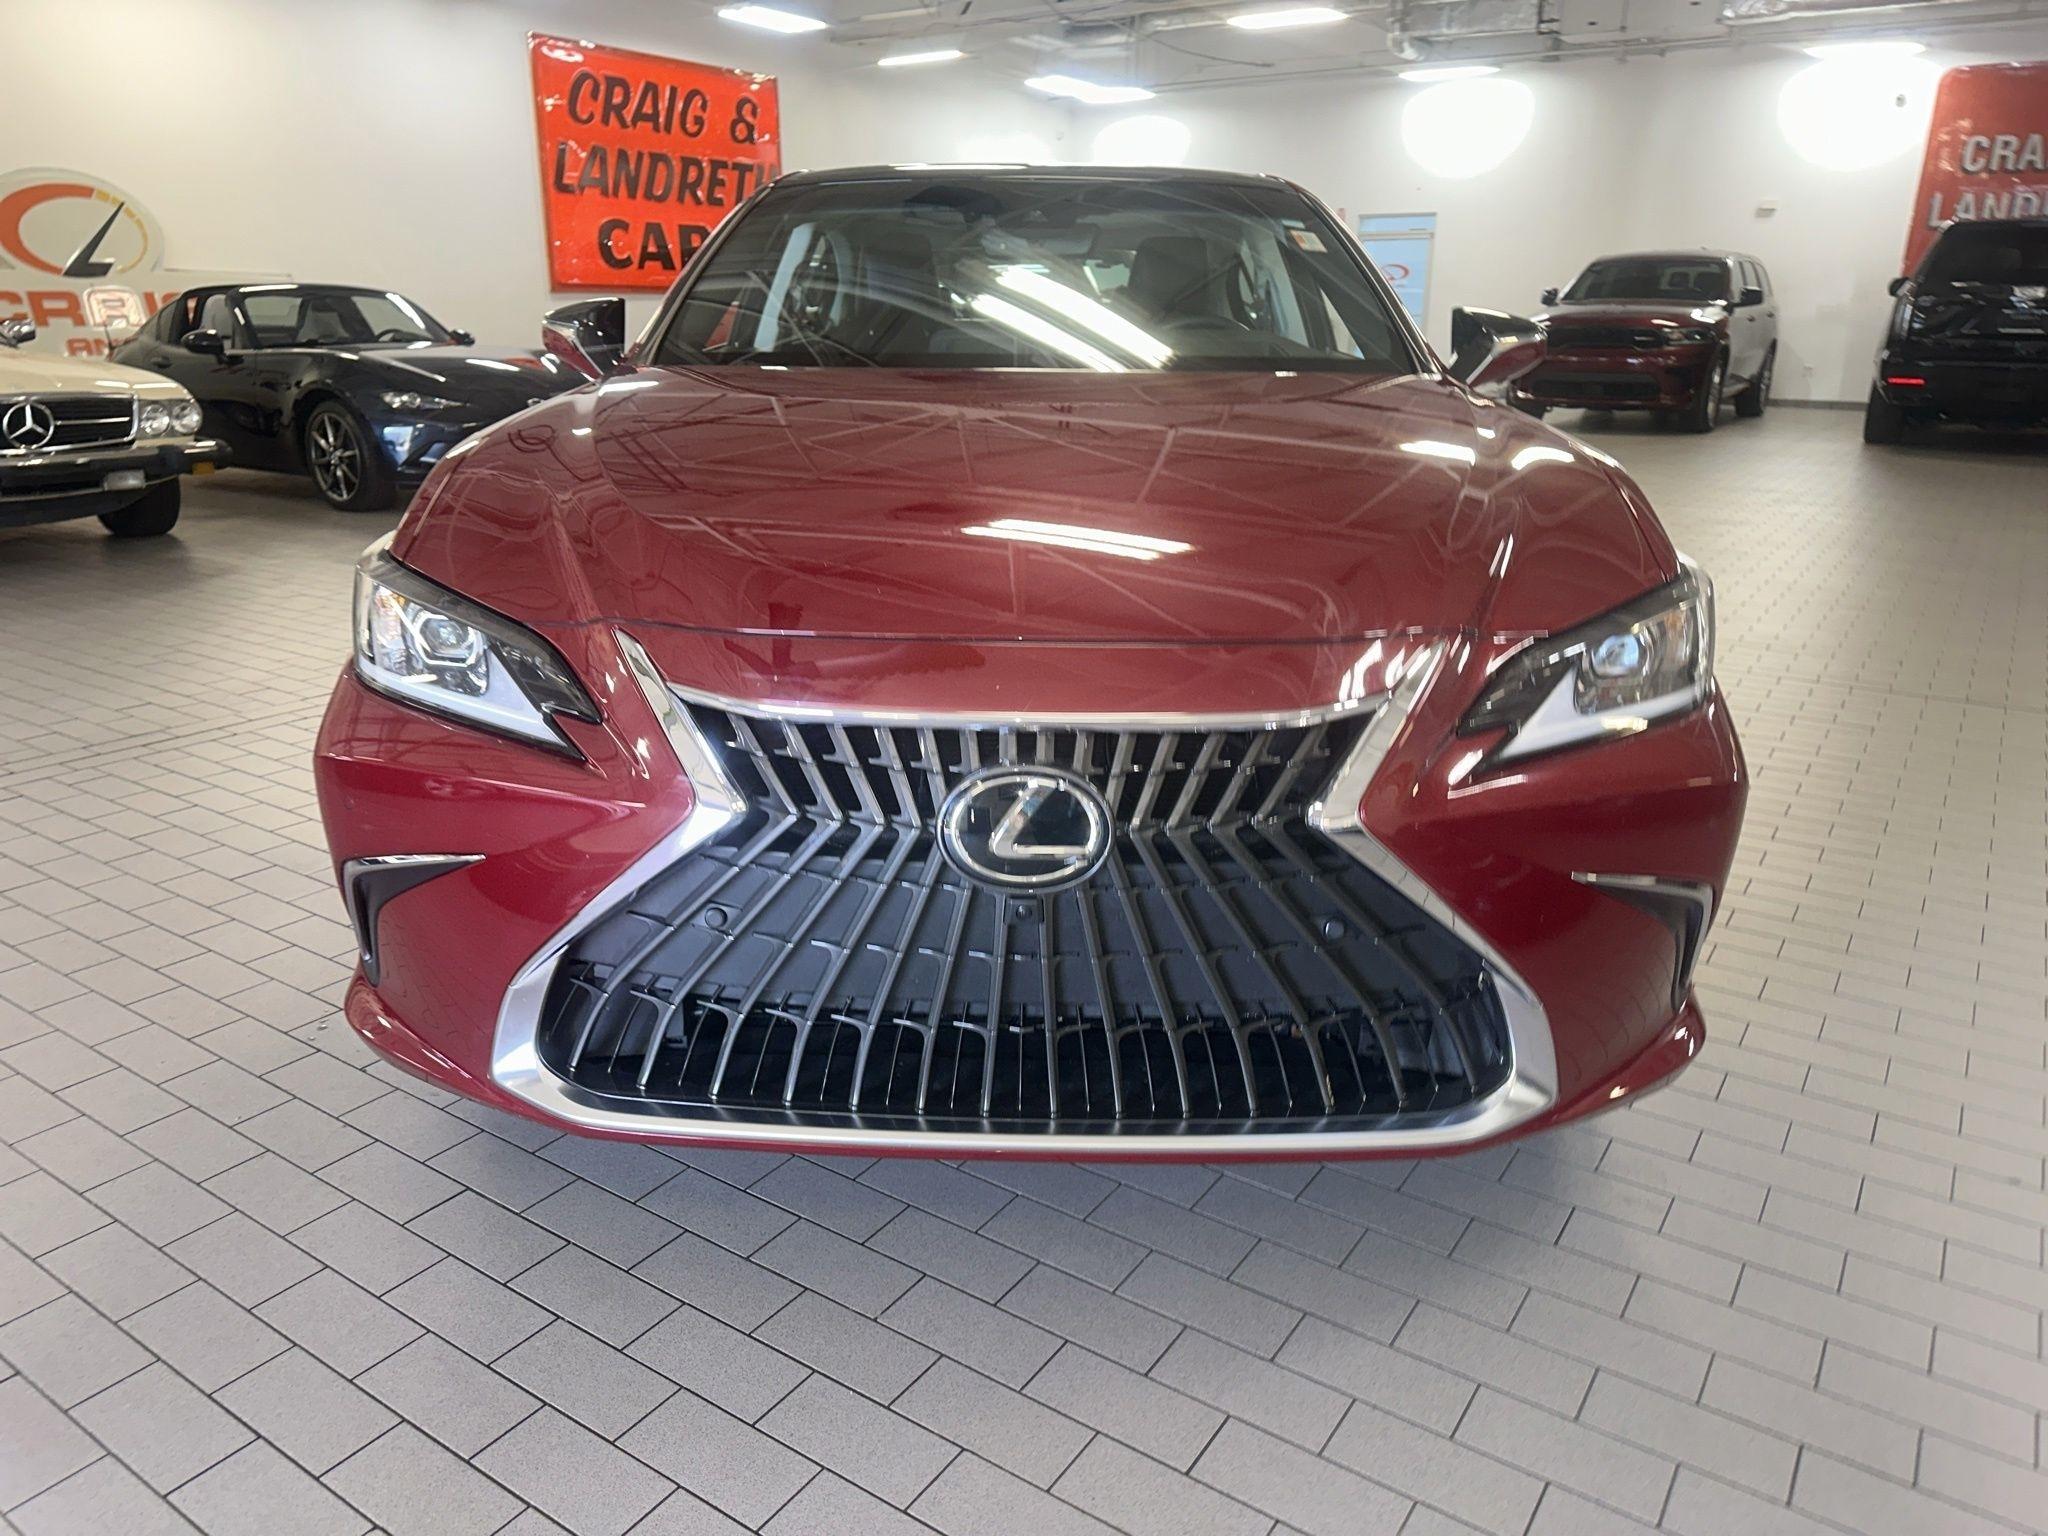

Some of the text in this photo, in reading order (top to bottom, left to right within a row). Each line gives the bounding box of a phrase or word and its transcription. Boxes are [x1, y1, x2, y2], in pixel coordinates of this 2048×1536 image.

[567, 69, 762, 145] CRAIG &
[1961, 132, 2048, 171] CRA
[1926, 189, 2048, 228] LAND
